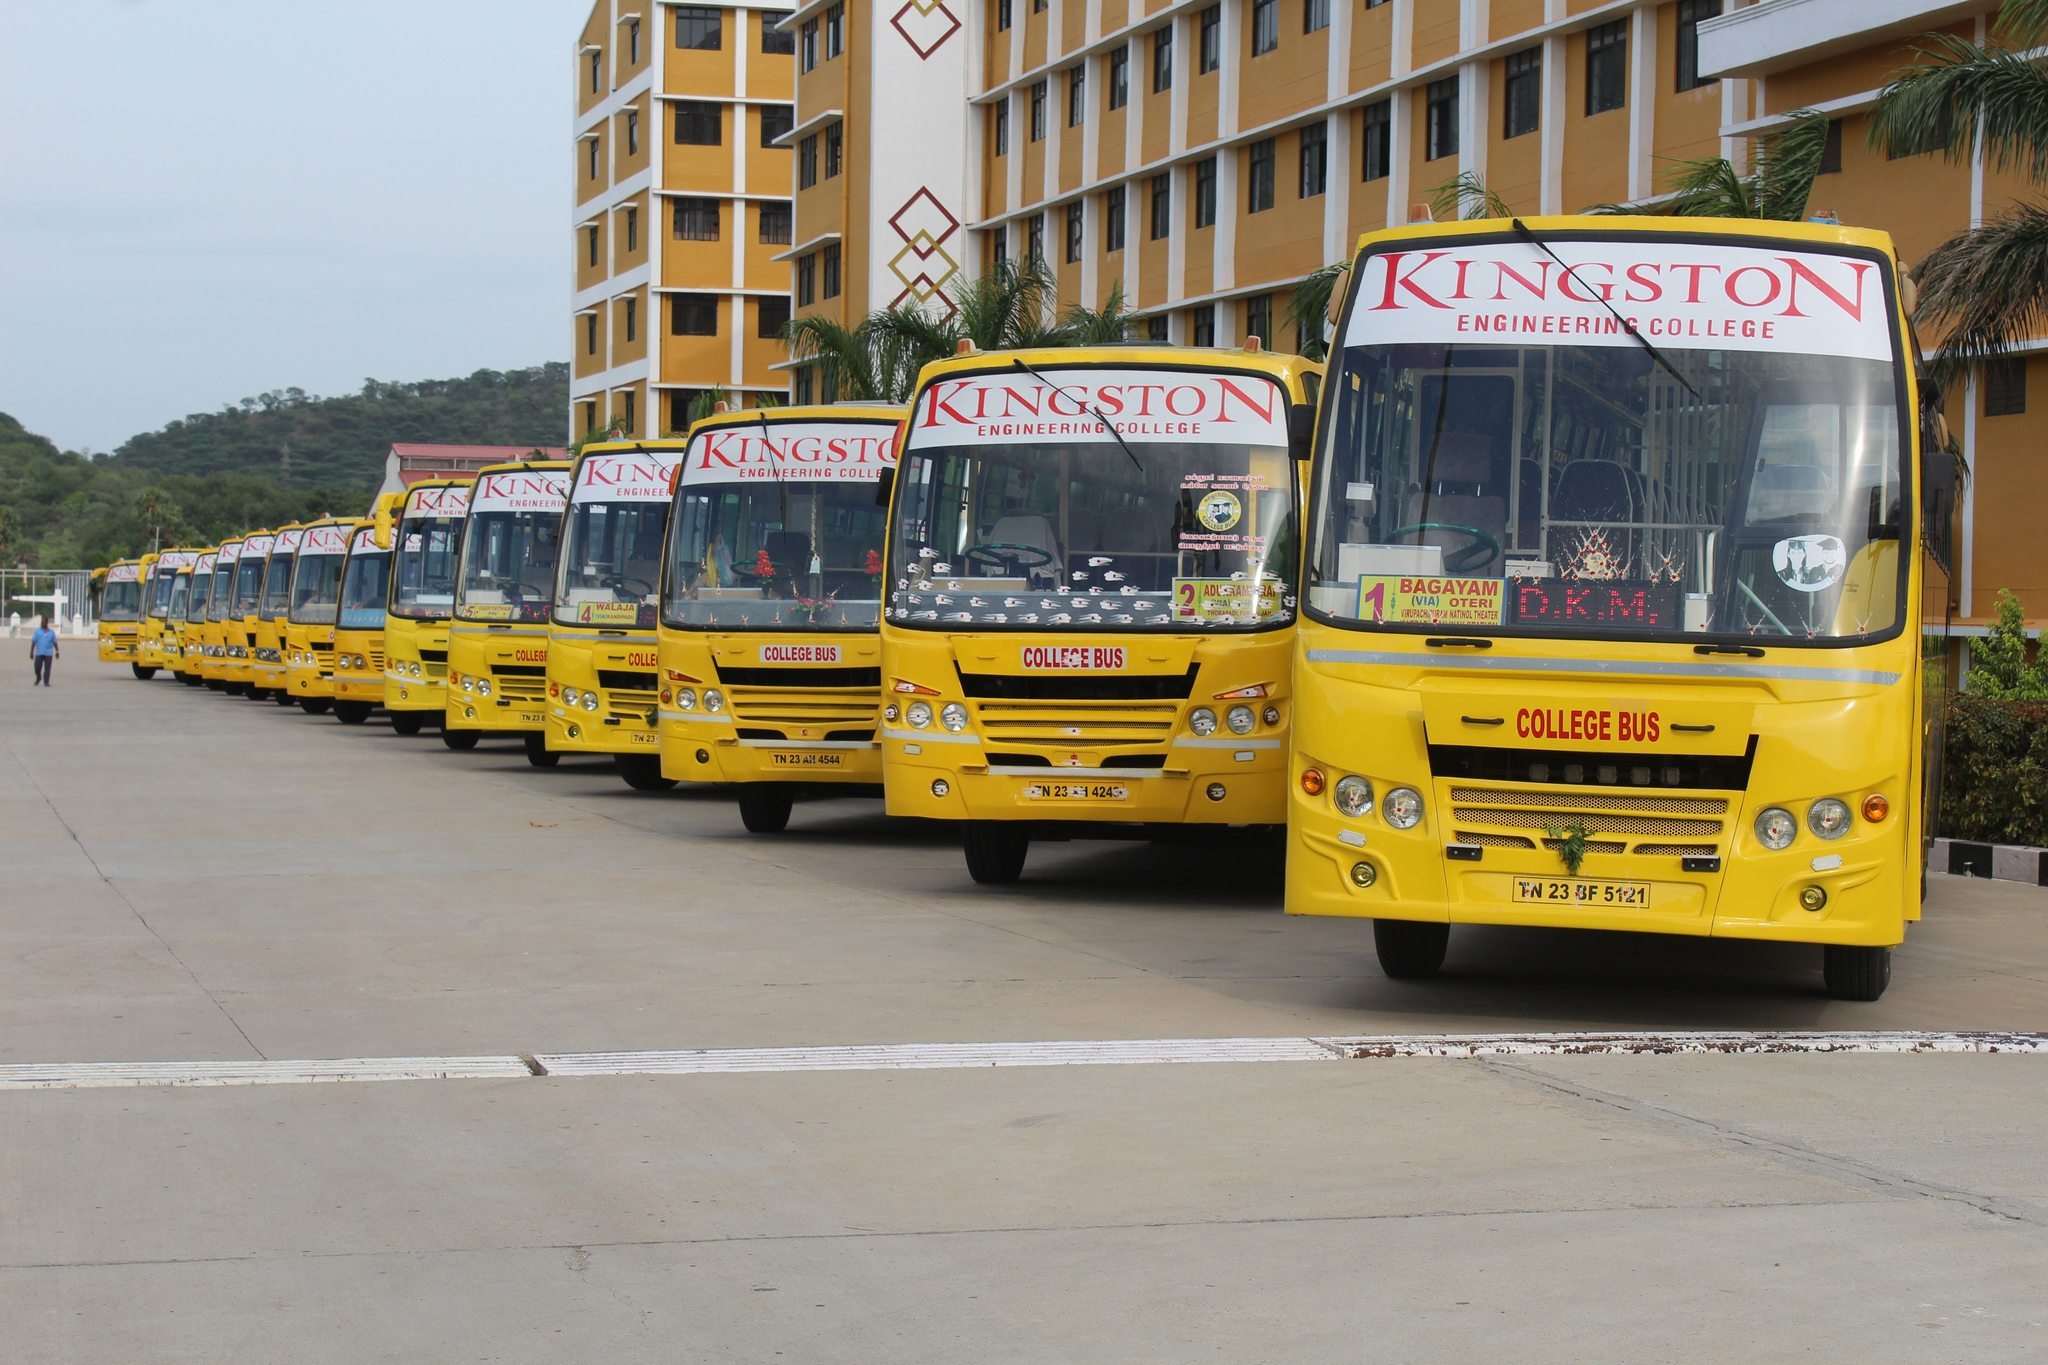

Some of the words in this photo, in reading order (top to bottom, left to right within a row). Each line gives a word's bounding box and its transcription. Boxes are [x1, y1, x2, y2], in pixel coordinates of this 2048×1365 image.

[1369, 252, 1873, 322] KINGSTON
[1457, 314, 1638, 337] ENGINEERING
[1650, 317, 1775, 339] COLLEGE
[918, 378, 1276, 429] KINGSTON
[978, 422, 1105, 436] ENGINEERING
[1116, 422, 1201, 435] COLLEGE
[740, 468, 832, 478] ENGINEERING
[1400, 579, 1498, 596] BAGAYAM
[596, 603, 634, 611] WALAJA
[1180, 584, 1195, 616] 2
[1365, 583, 1384, 621] 1
[1412, 595, 1439, 607] (VIA)
[1449, 598, 1492, 608] OTERI
[581, 605, 591, 623] 4
[1474, 610, 1498, 619] THEATER
[764, 647, 812, 661] COLLEGE
[815, 647, 836, 661] BUS
[1023, 648, 1088, 668] COLLEGE
[1093, 648, 1123, 668] BUS
[1516, 708, 1612, 741] COLLEGE
[1618, 711, 1660, 742] BUS
[773, 754, 786, 764] TN
[789, 754, 800, 764] 23
[818, 755, 840, 764] 4544
[1054, 786, 1068, 797] 23
[1519, 882, 1543, 898] TN
[1549, 883, 1569, 900] 23
[1575, 884, 1599, 901] BF
[1604, 886, 1645, 904] 5121
